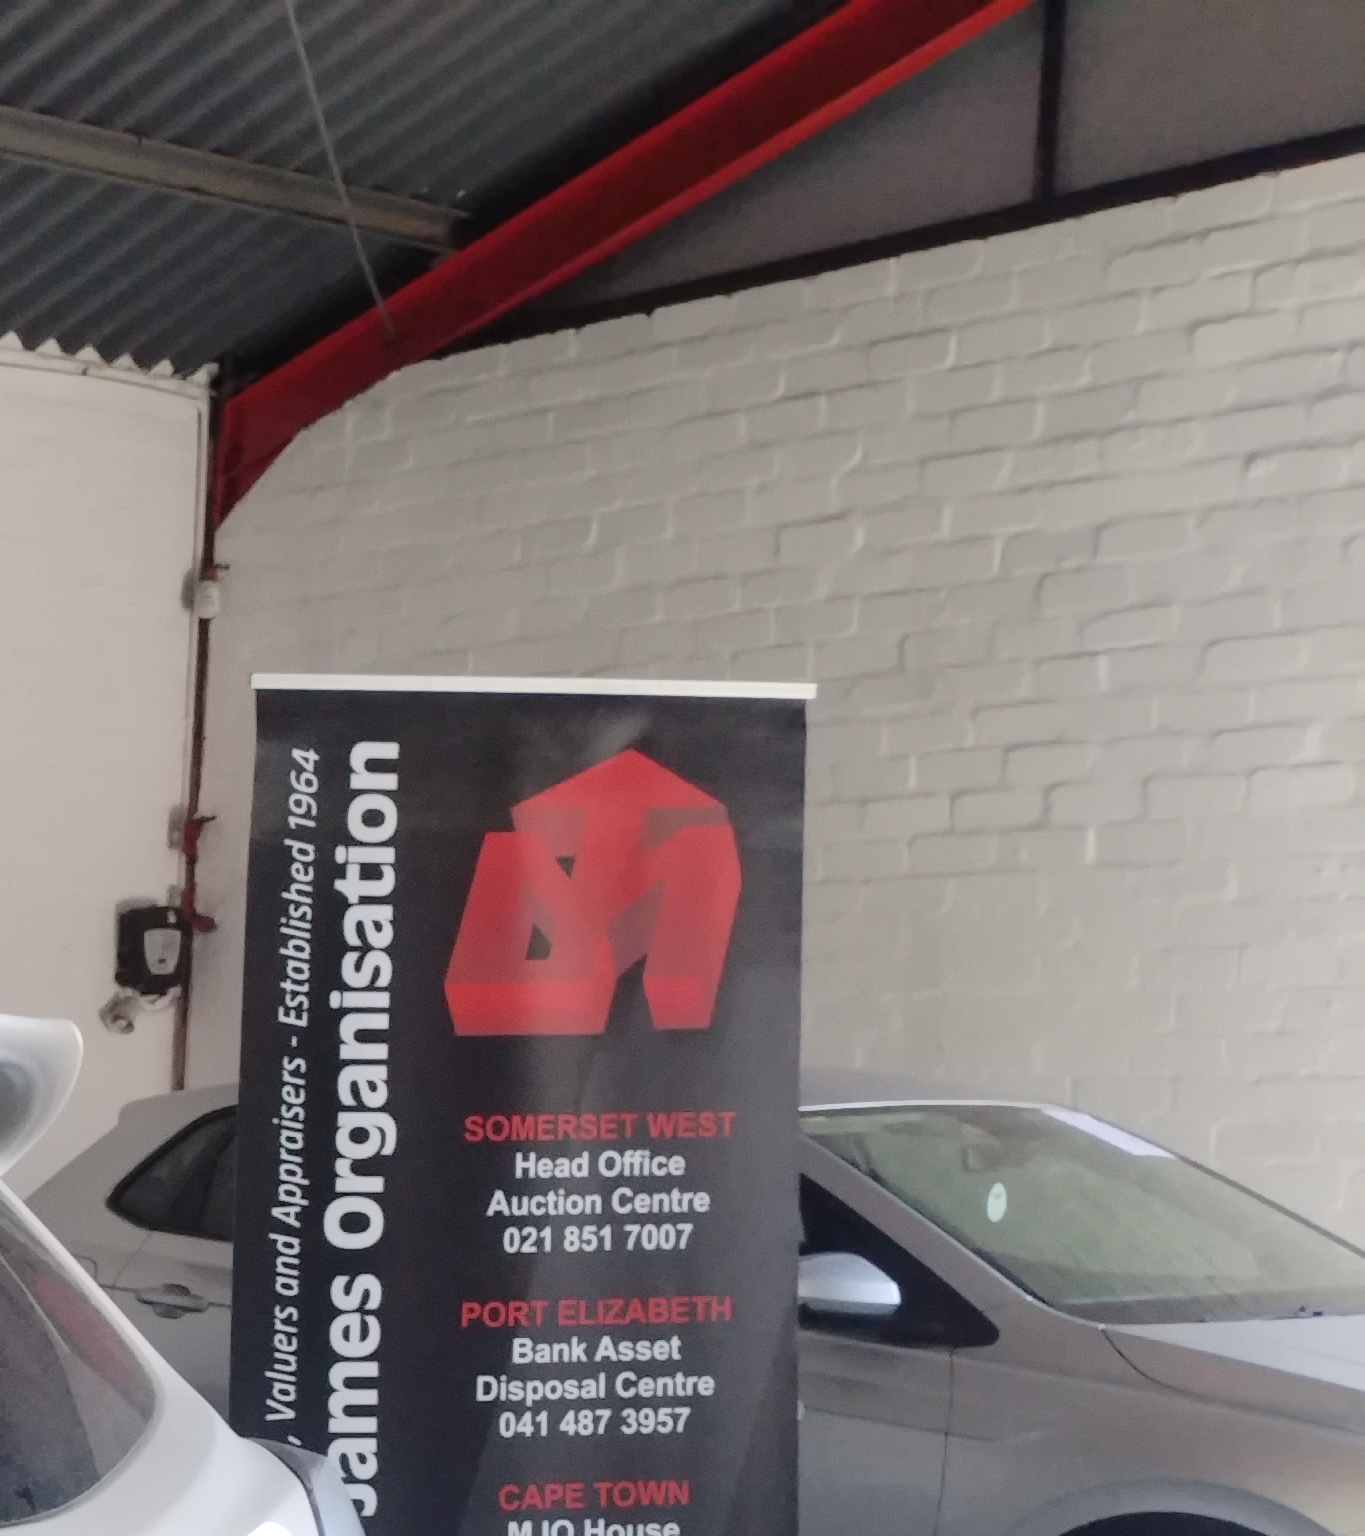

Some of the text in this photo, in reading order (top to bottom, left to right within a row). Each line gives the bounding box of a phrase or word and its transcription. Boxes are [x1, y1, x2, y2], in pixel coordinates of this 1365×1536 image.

[287, 747, 320, 830] 1964
[277, 838, 316, 1028] Established
[323, 741, 400, 1250] Organisation
[271, 1055, 310, 1228] Appraisers
[463, 1111, 737, 1142] SOMERSET WEST
[515, 1149, 686, 1179] Head Office
[486, 1187, 711, 1217] Auction Centre
[502, 1222, 694, 1254] 021 851 7007
[268, 1232, 301, 1297] and
[460, 1295, 734, 1328] PORT ELIZABETH
[264, 1304, 300, 1422] Valuers
[512, 1335, 682, 1364] Bank Asset
[475, 1371, 716, 1407] Disposal Centre
[498, 1407, 691, 1438] 041 487 3957
[499, 1479, 691, 1511] CAPE TOWN
